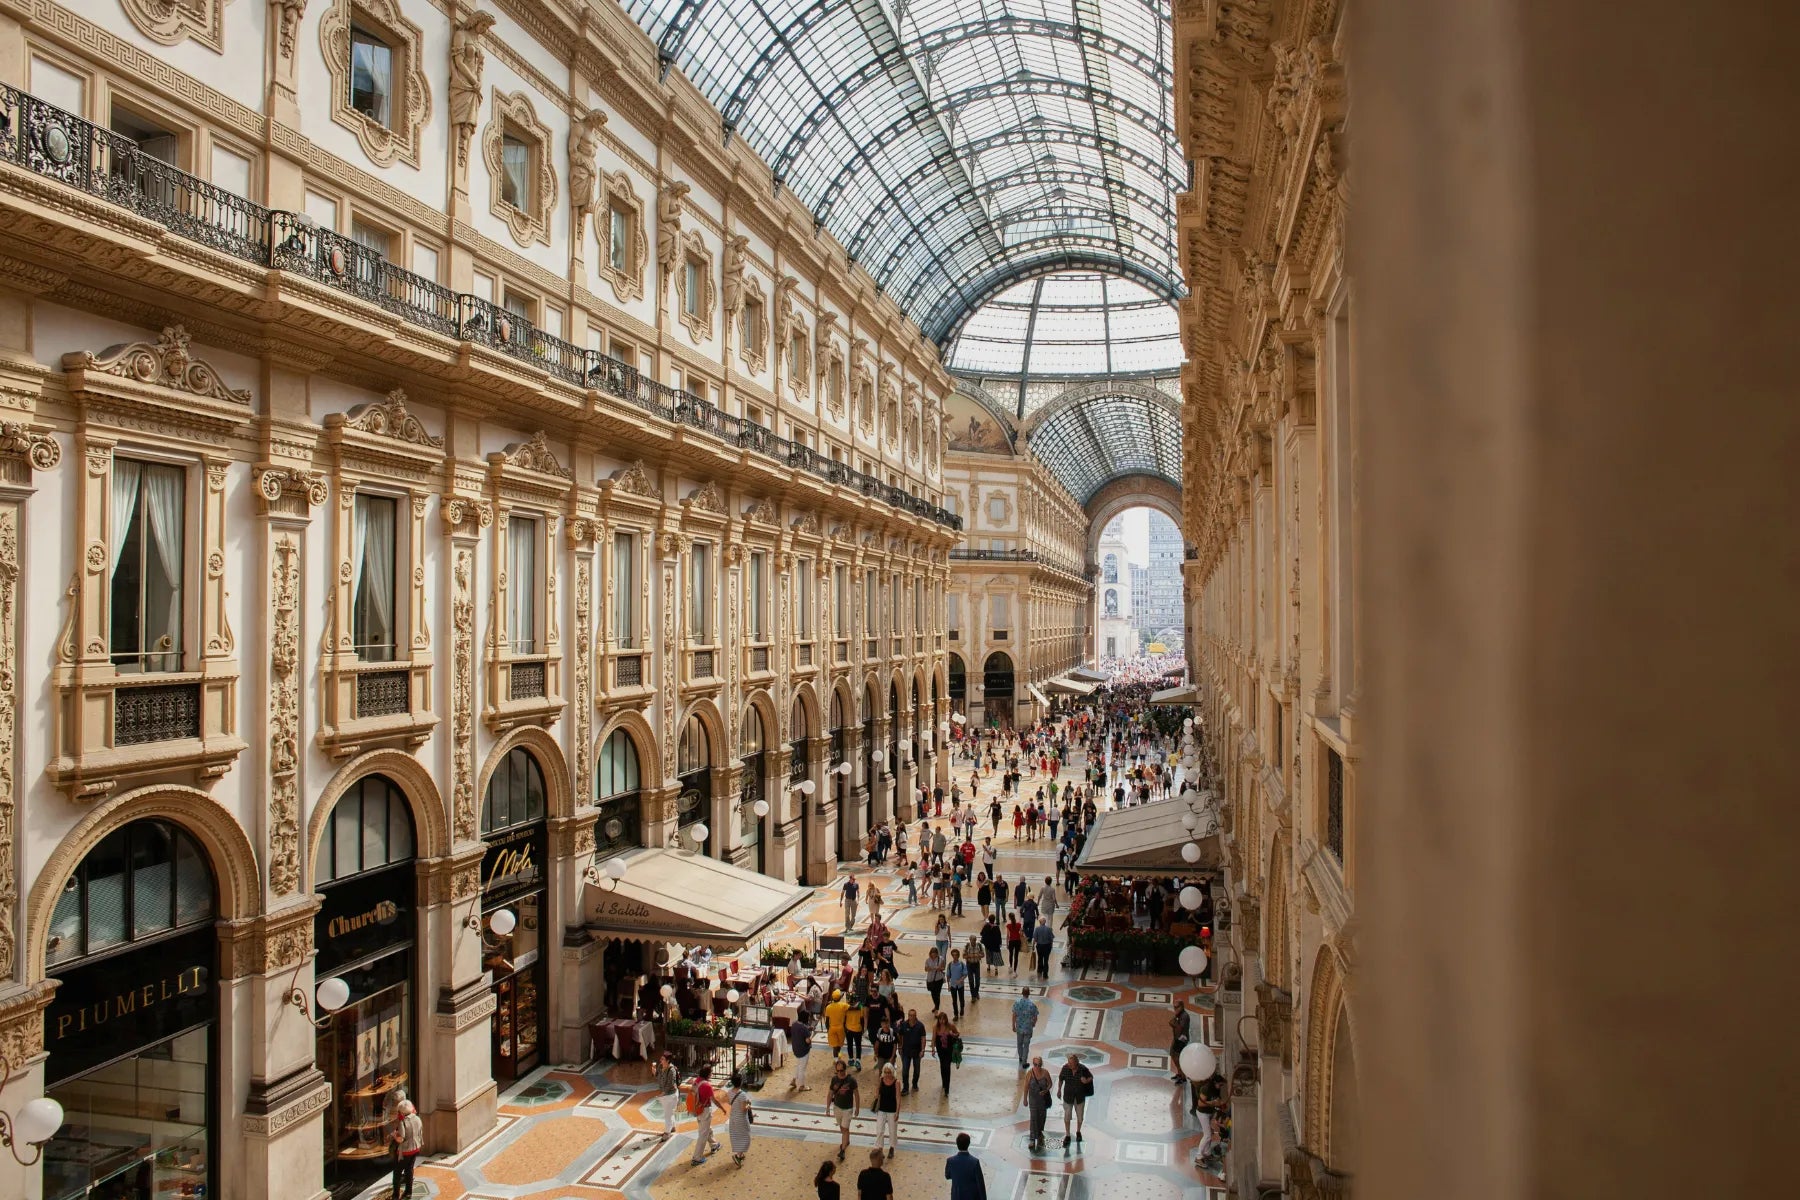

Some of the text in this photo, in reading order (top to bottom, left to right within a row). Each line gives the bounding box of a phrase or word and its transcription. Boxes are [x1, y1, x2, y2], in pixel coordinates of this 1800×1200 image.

[328, 900, 396, 938] Church's
[595, 901, 650, 918] il Salotto
[57, 965, 201, 1040] PIUMELLI
